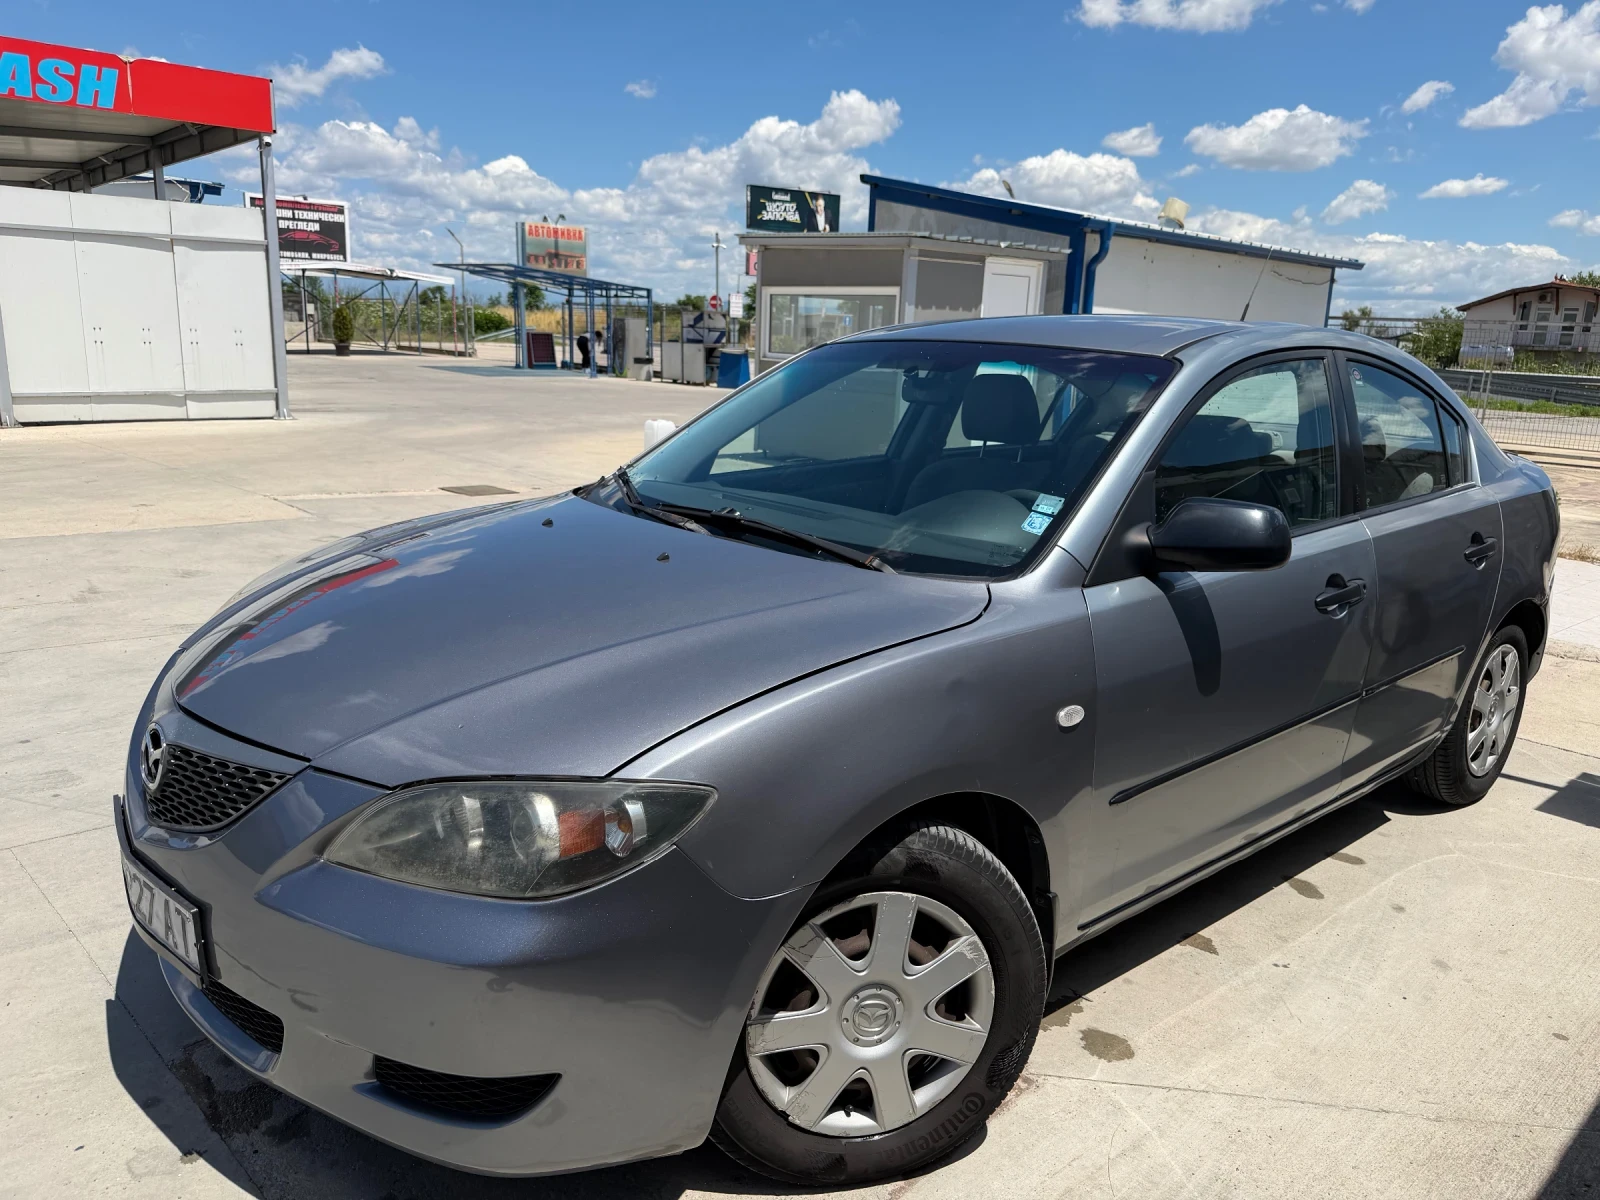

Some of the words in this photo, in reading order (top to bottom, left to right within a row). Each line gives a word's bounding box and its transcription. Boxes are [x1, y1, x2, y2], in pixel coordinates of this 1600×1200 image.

[294, 210, 345, 223] ТЕХНИЧЕСКИ
[761, 211, 801, 222] ЗАПОЧВА
[278, 219, 320, 232] ПРЕГЛЕДИ
[527, 225, 583, 241] АВТОМИВКА
[279, 250, 311, 260] ТОМОБИЛИ,
[164, 898, 191, 959] AT
